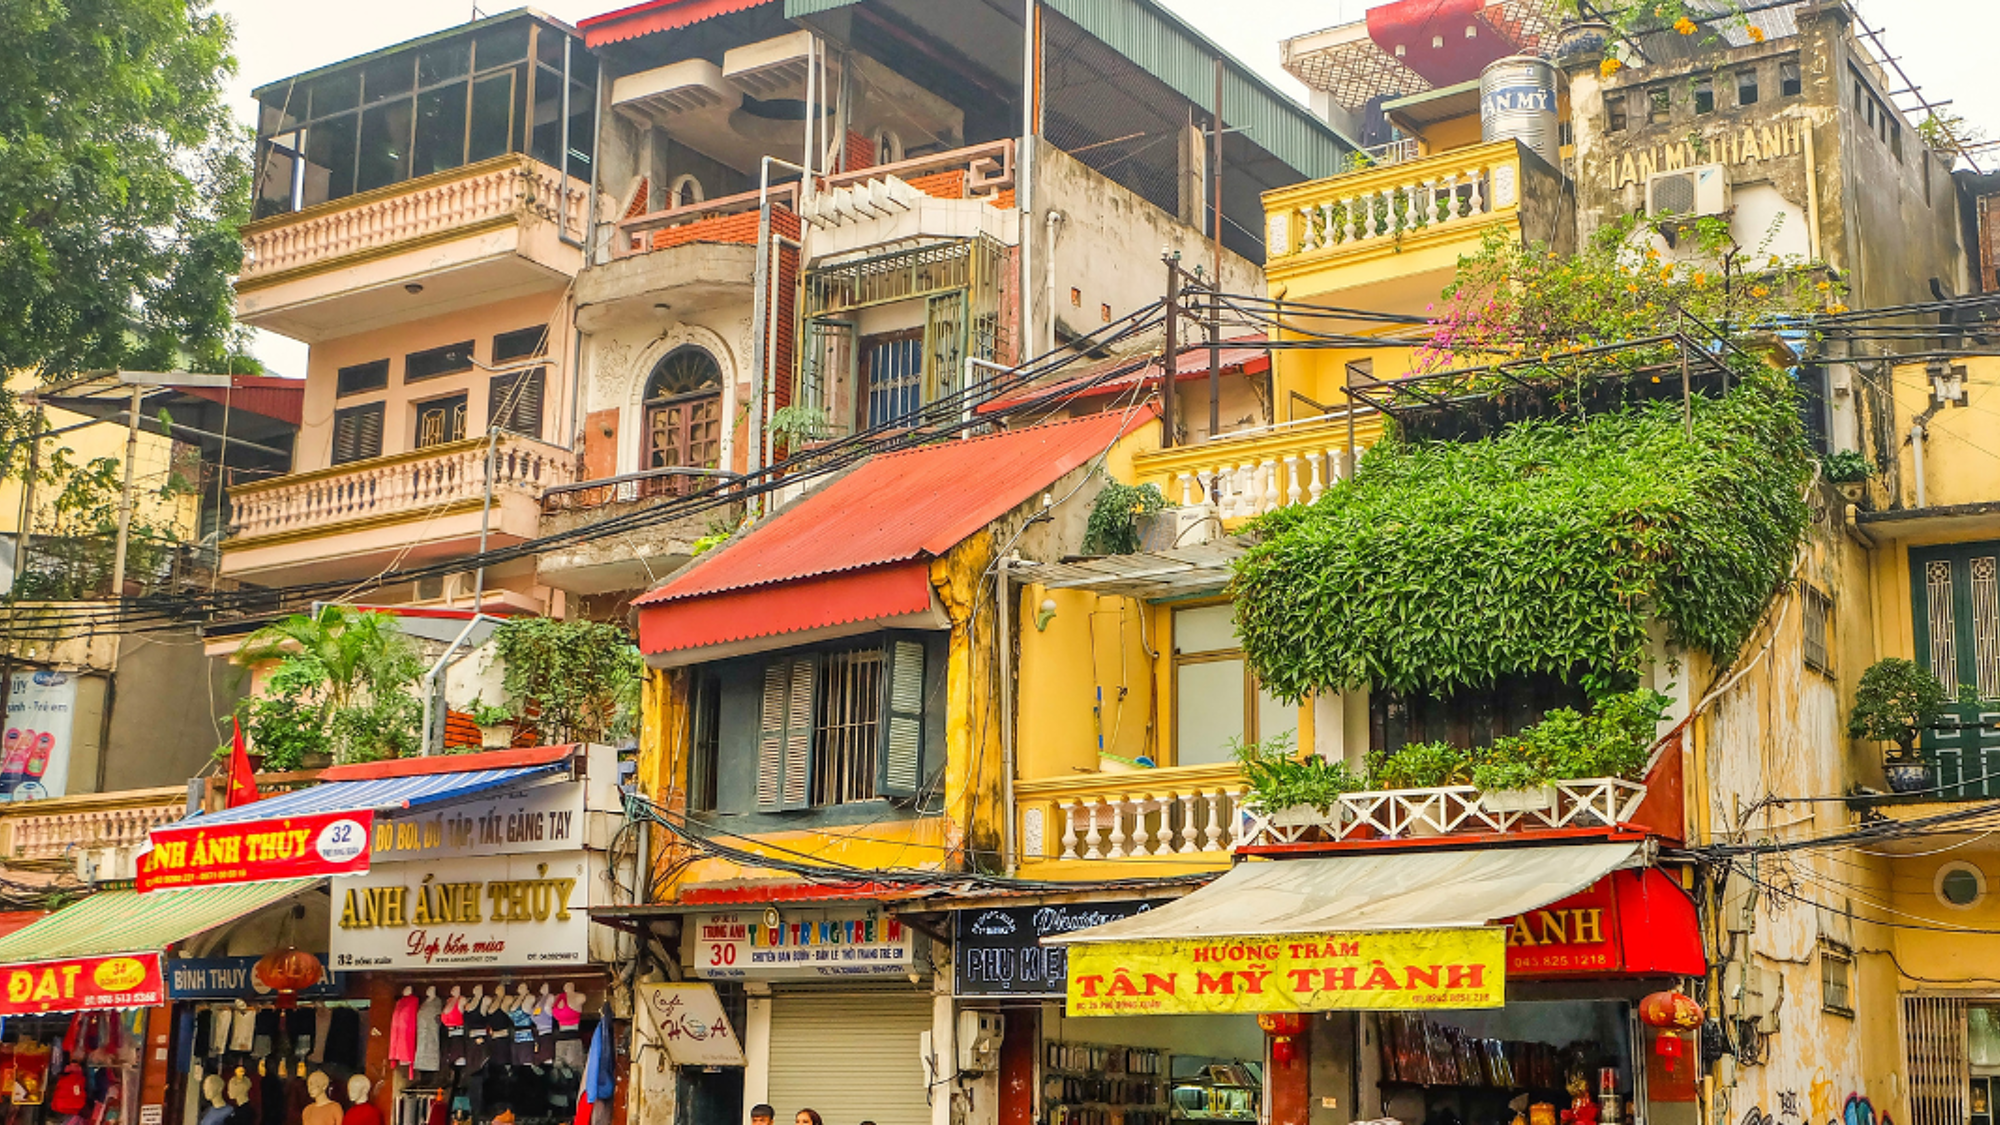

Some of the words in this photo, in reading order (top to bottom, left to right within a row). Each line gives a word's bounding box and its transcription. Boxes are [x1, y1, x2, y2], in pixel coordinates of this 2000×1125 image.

[331, 824, 352, 843] 32
[506, 808, 544, 843] GĂNG
[549, 810, 573, 840] TAY
[190, 831, 241, 867] ÁNH
[246, 820, 311, 862] THỦY
[338, 886, 408, 928] ANH
[411, 873, 483, 925] ÁNH
[488, 862, 576, 922] THỦY
[729, 924, 745, 938] ANH
[791, 920, 841, 946] TRANG
[878, 917, 902, 943] EM
[337, 954, 353, 966] 32
[710, 943, 736, 966] 30
[967, 948, 1014, 989] PHỤ
[1193, 943, 1280, 963] HƯƠNG
[8, 965, 82, 1010] ĐẠT
[1076, 967, 1178, 998] TÂN
[1194, 963, 1273, 995] MỸ
[1286, 959, 1486, 992] THÀNH
